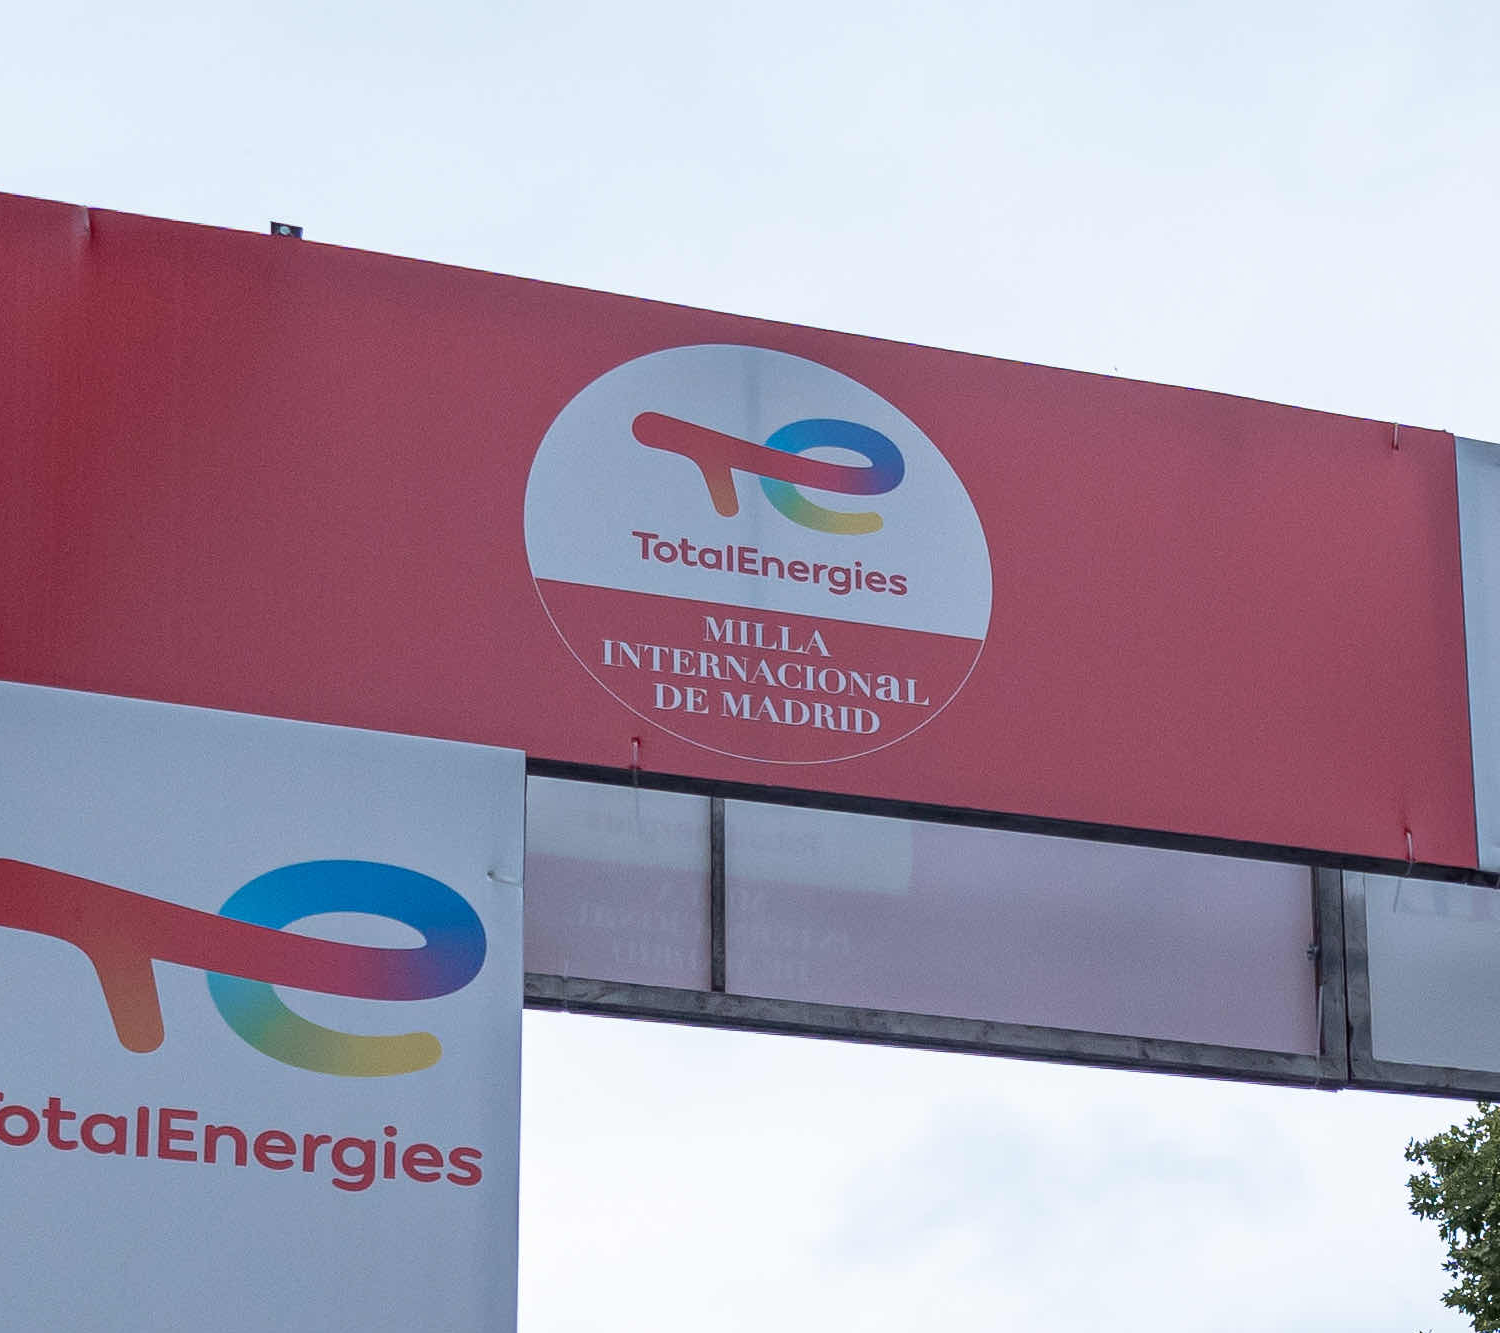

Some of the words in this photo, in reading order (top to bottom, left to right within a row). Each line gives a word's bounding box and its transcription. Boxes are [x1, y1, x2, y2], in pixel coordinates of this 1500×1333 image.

[632, 530, 908, 597] TotalEnergies
[701, 615, 833, 658] MILLA
[653, 682, 710, 715] DE
[720, 690, 882, 736] MADRID
